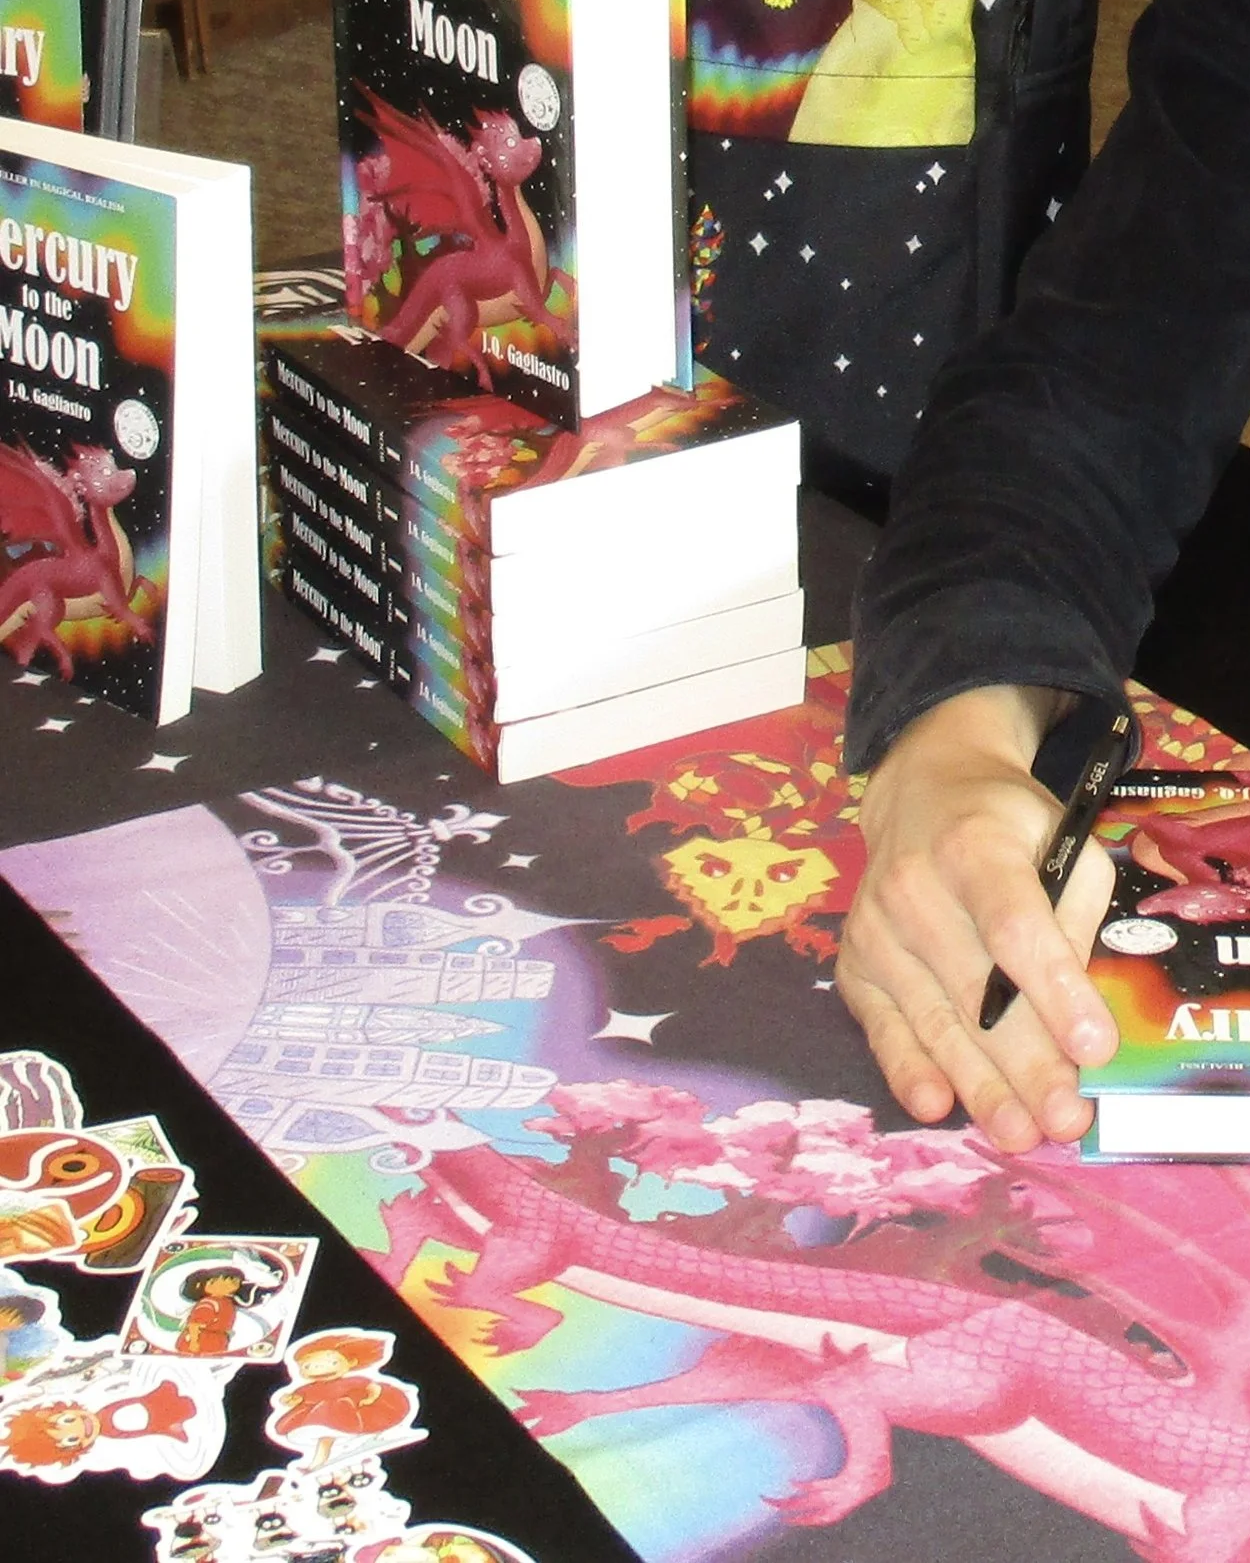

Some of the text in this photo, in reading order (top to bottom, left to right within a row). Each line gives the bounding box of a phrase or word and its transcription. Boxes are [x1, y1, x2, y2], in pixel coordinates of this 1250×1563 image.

[29, 178, 41, 189] IN
[42, 181, 84, 202] MAGICAL
[0, 217, 138, 312] ercury
[22, 283, 73, 321] to the
[0, 305, 100, 392] Moon
[482, 330, 570, 391] J.Q. Gagliastro
[8, 379, 92, 423] J.Q. Gagliastro
[277, 359, 316, 407] Mercury
[316, 391, 326, 412] to
[327, 399, 341, 424] the
[342, 406, 371, 445] Moon
[272, 415, 310, 464] Mercury
[312, 449, 322, 470] to
[323, 456, 337, 482] the
[338, 464, 367, 505] Moon
[280, 464, 317, 513] Mercury
[318, 498, 328, 519] to
[329, 506, 343, 532] the
[344, 515, 372, 555] Moon
[292, 512, 327, 561] Mercury
[329, 546, 338, 568] to
[338, 555, 352, 580] the
[353, 563, 379, 605] Moon
[292, 568, 328, 619] Mercury
[330, 604, 339, 625] to
[340, 611, 353, 638] the
[354, 621, 382, 663] Moon
[1085, 761, 1109, 796] S-GEL
[1110, 785, 1250, 800] J.Q. Gagliastr
